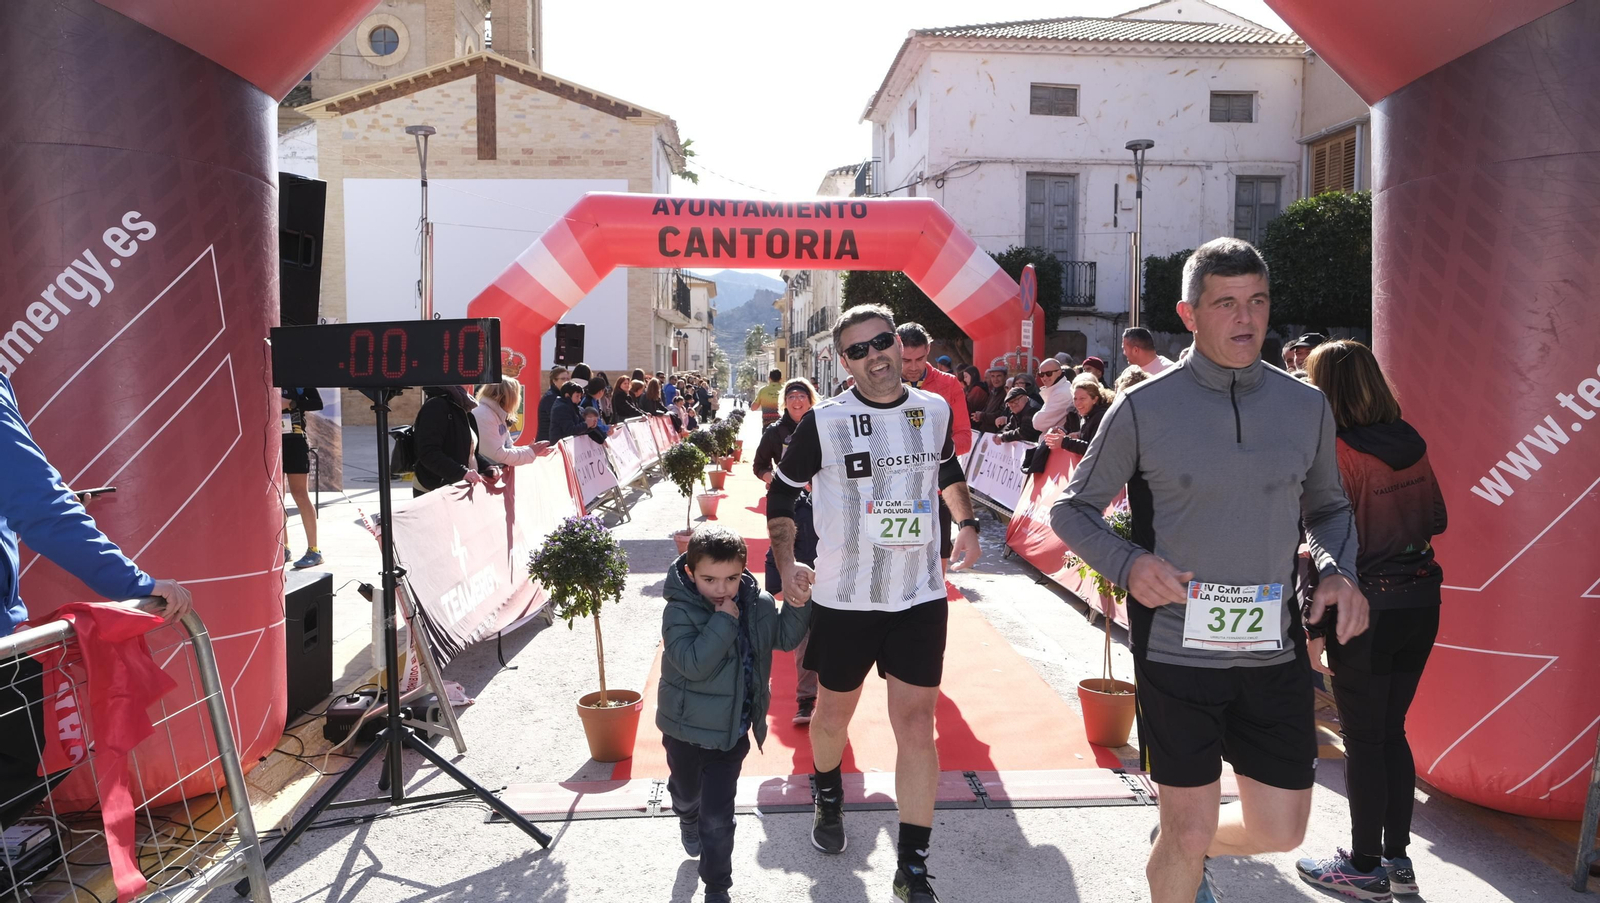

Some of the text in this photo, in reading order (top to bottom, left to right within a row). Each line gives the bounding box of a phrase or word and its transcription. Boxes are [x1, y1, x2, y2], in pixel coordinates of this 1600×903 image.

[652, 197, 868, 219] AYUNTAMIENTO
[658, 226, 860, 260] CANTORIA
[850, 413, 873, 437] 18
[1470, 363, 1600, 506] www.te
[880, 517, 921, 538] 274
[1200, 593, 1254, 604] LA PÓLVORA
[1204, 584, 1240, 594] IV CxM
[1207, 607, 1264, 632] 372
